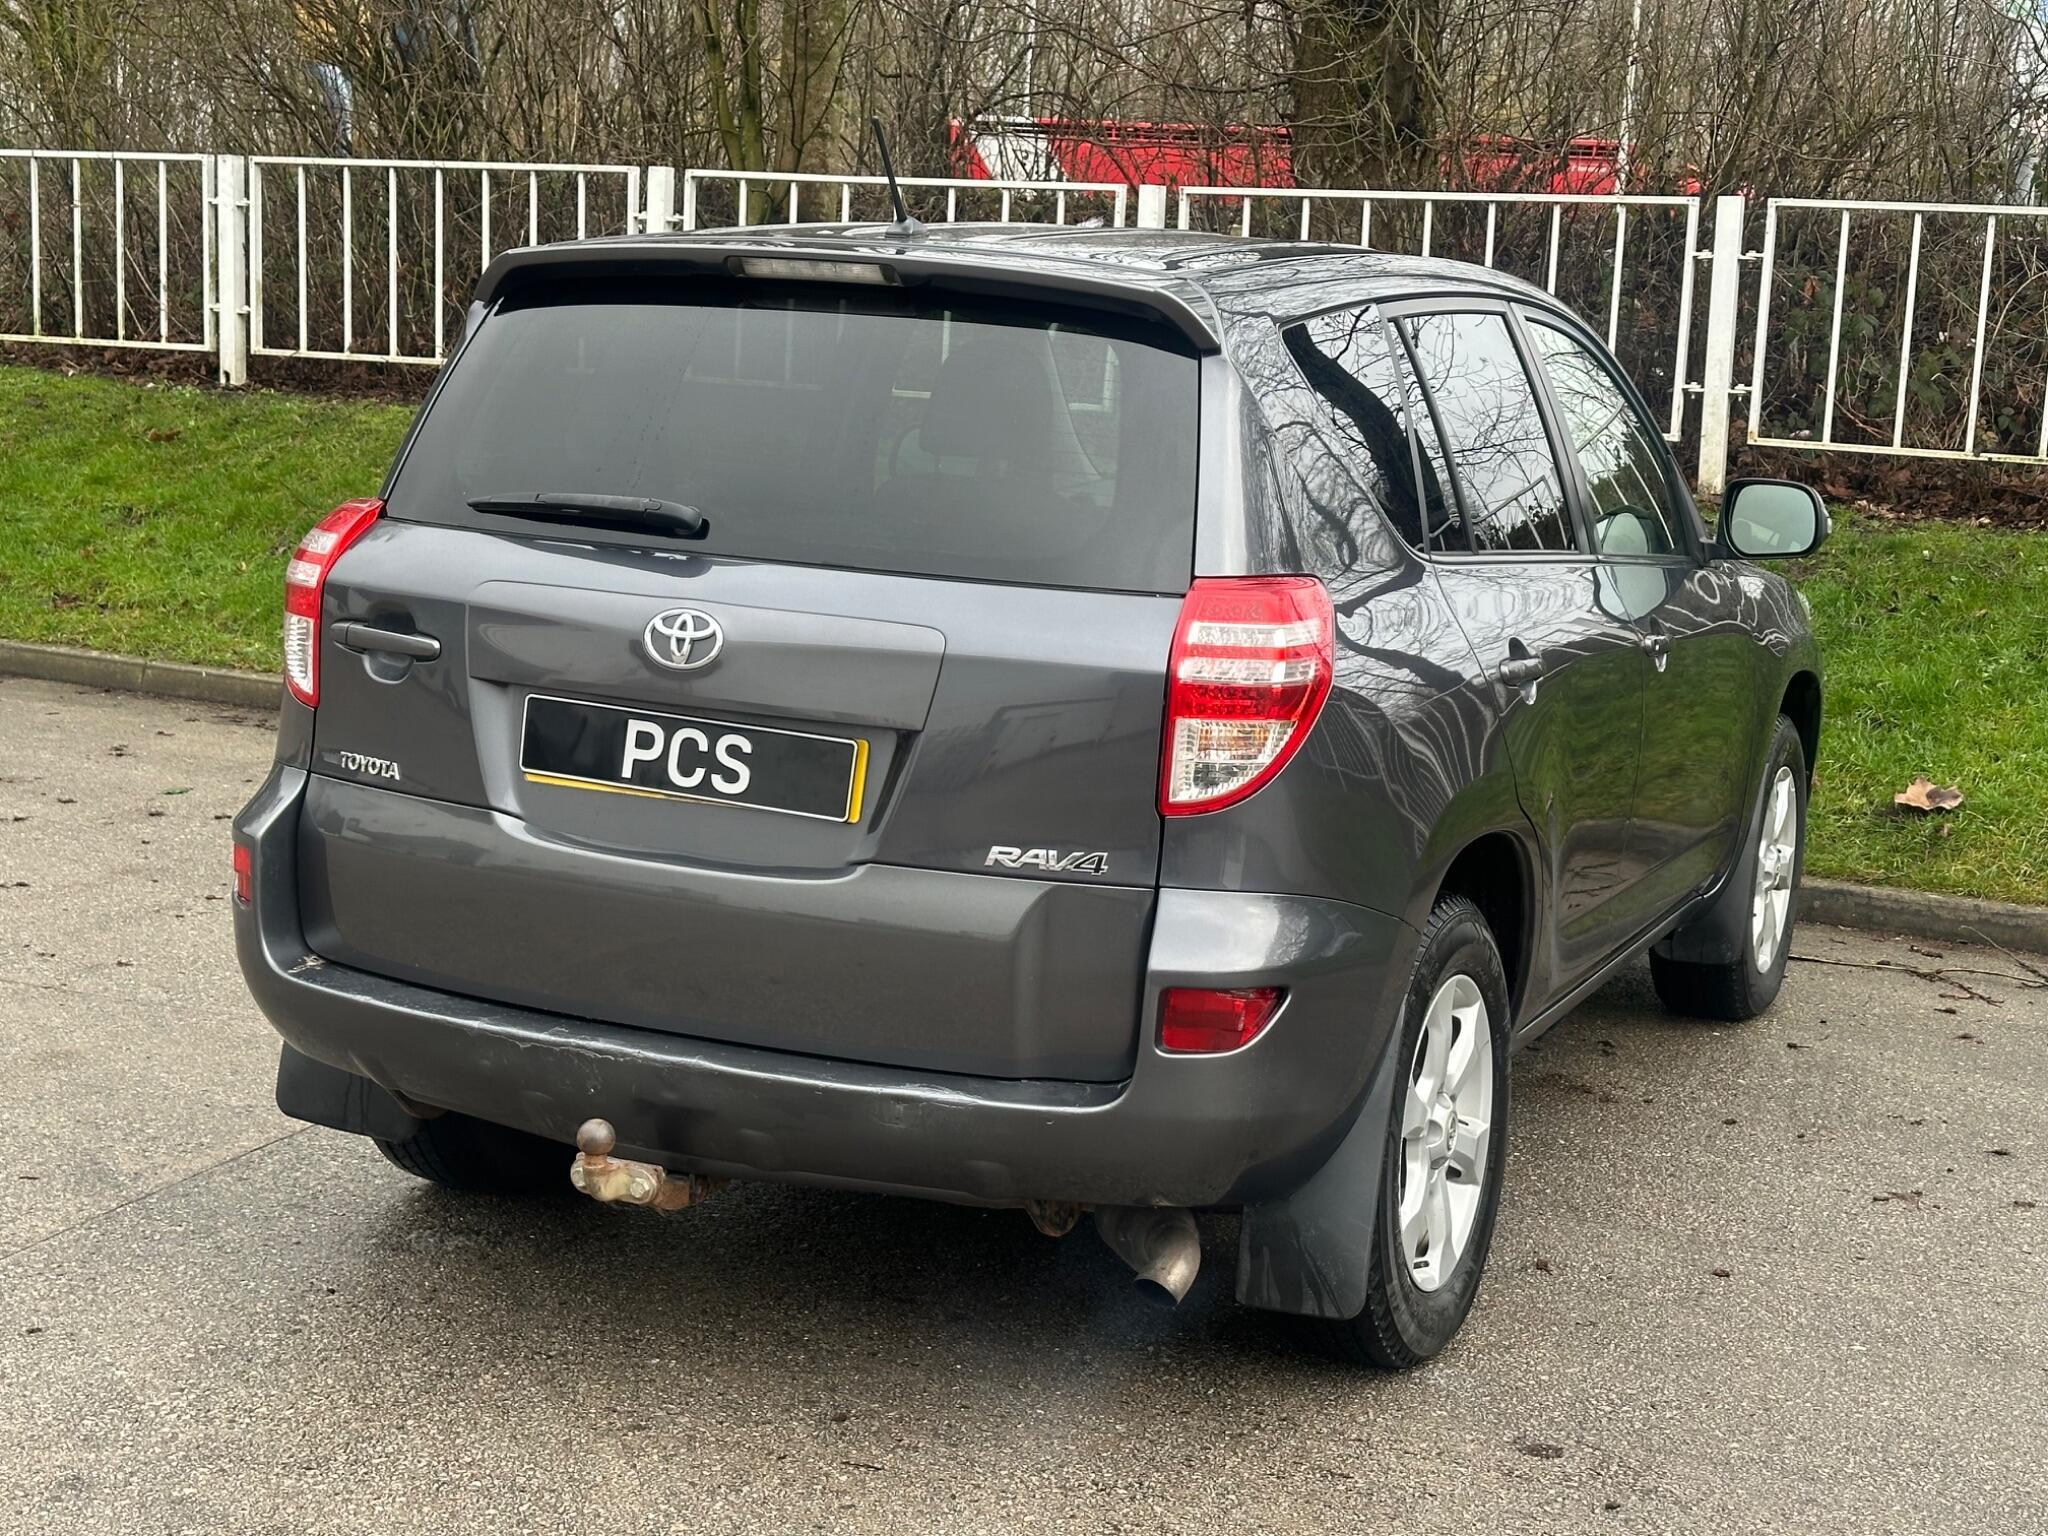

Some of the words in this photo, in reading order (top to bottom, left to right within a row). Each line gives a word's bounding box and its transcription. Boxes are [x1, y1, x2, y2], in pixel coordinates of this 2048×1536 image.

[340, 750, 400, 780] TOYOTA
[621, 718, 752, 794] PCS
[983, 845, 1109, 876] RAV4
